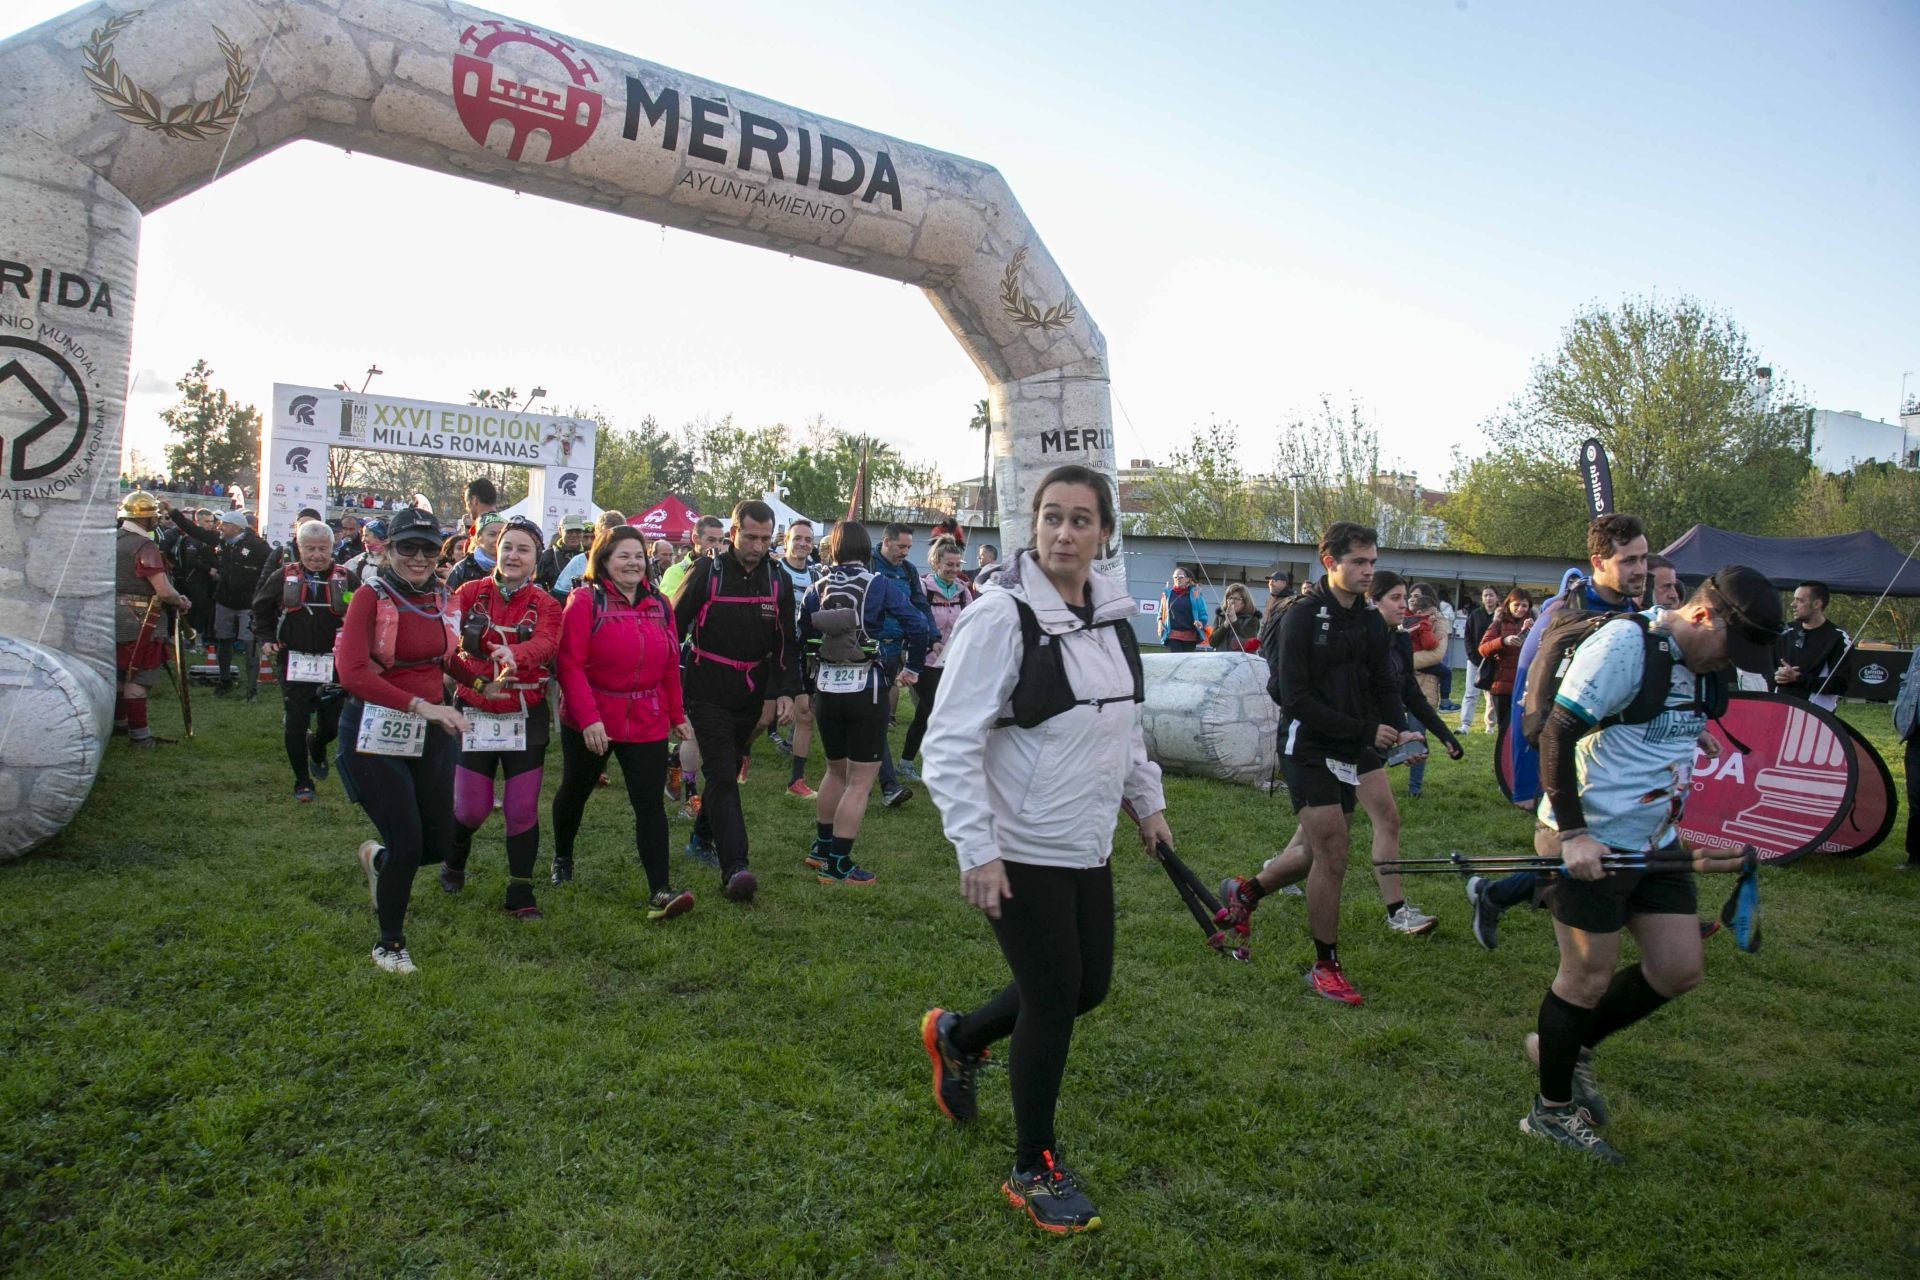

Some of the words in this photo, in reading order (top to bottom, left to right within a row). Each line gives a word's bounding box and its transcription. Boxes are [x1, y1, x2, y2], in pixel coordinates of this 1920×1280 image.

[622, 75, 904, 211] MÉRIDA
[678, 169, 846, 226] AYUNTAMIENTO
[38, 322, 98, 380] MUNDIAL
[373, 403, 431, 431] XXVI
[373, 427, 444, 450] MILLAS
[450, 435, 540, 459] ROMANAS
[381, 720, 412, 740] 525
[493, 722, 501, 737] 9
